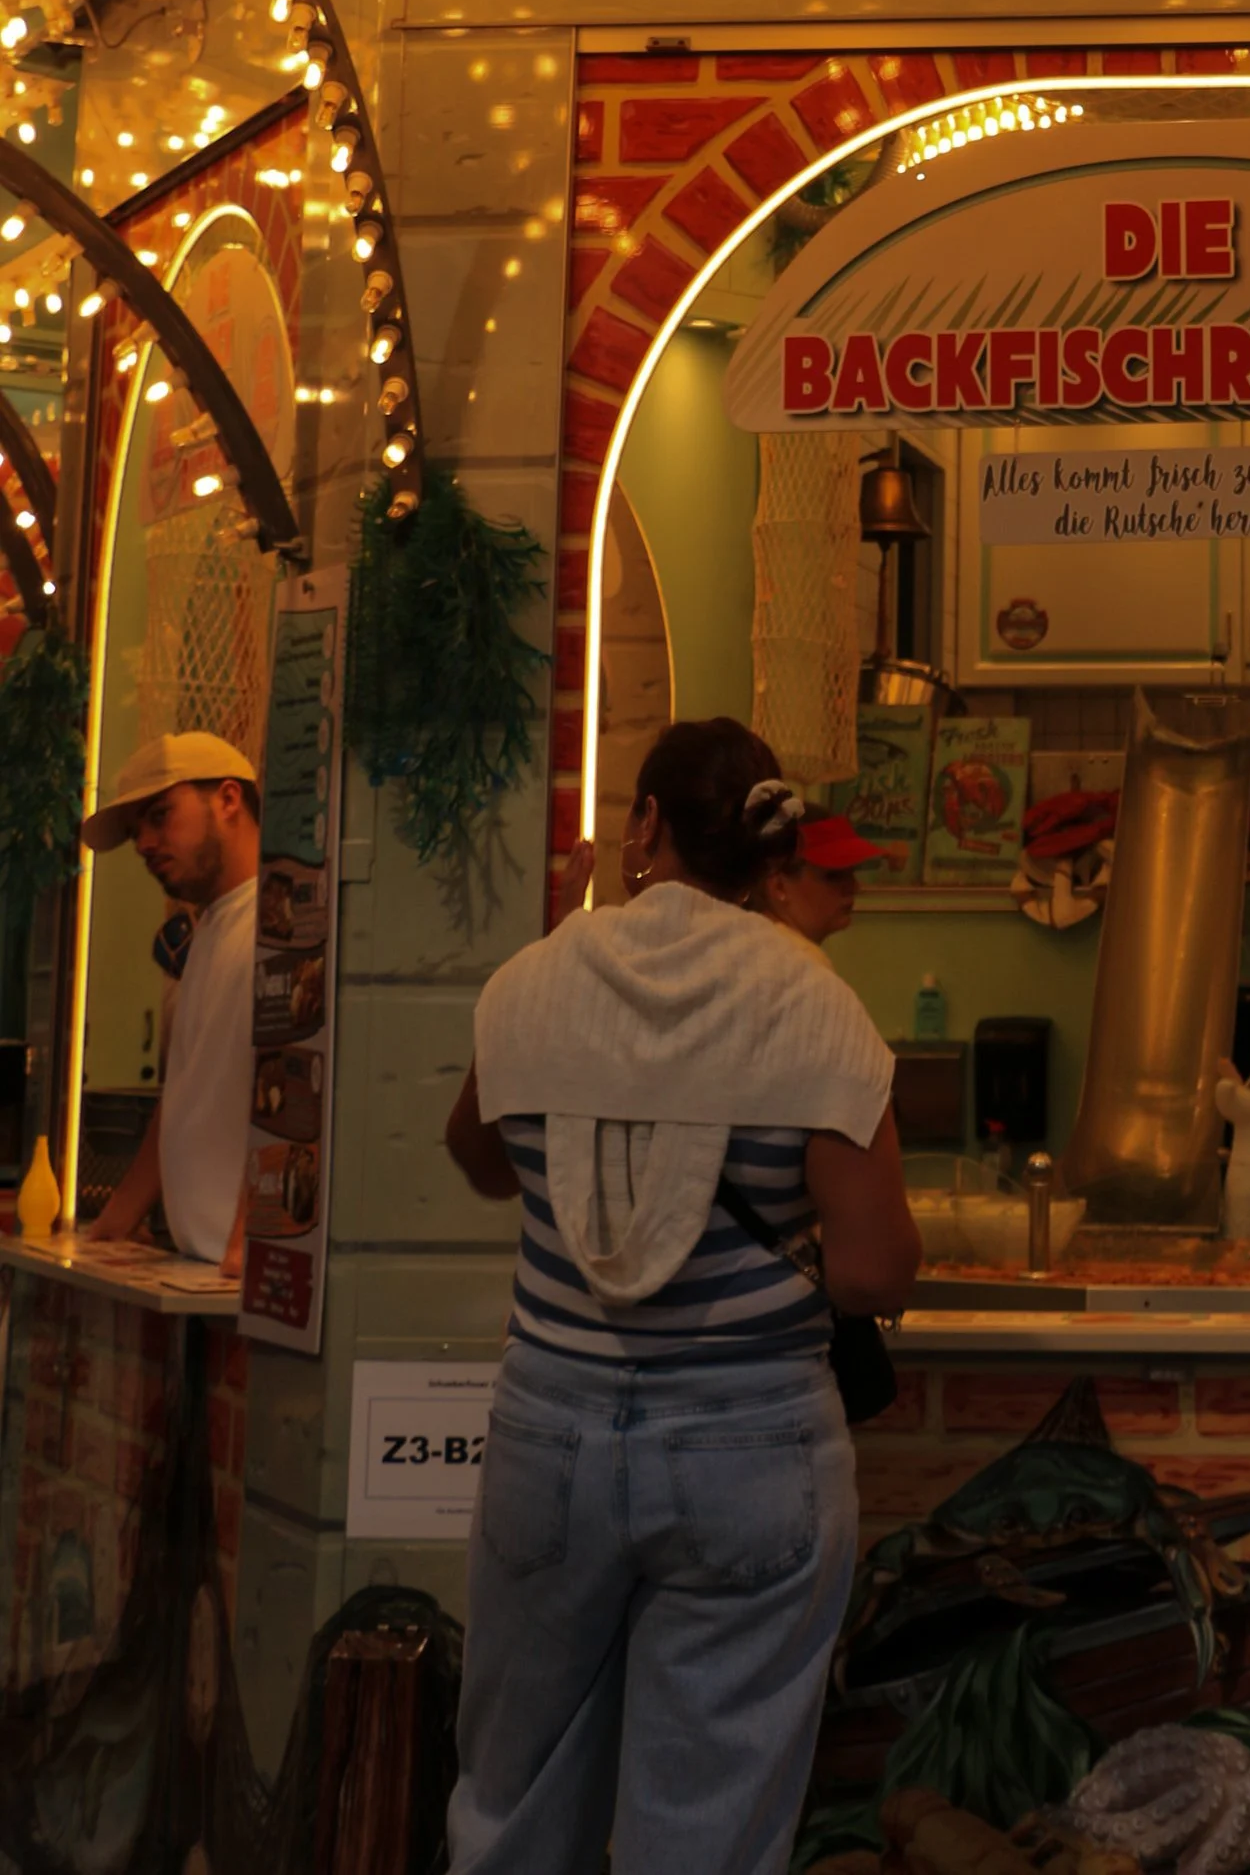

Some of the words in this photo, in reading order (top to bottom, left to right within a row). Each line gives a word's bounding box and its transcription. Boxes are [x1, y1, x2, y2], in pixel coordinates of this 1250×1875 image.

[1102, 198, 1236, 281] DIE
[982, 455, 1044, 501] Alles
[1053, 457, 1134, 492] kommt
[1145, 453, 1223, 498] frisch
[1054, 502, 1094, 536] die
